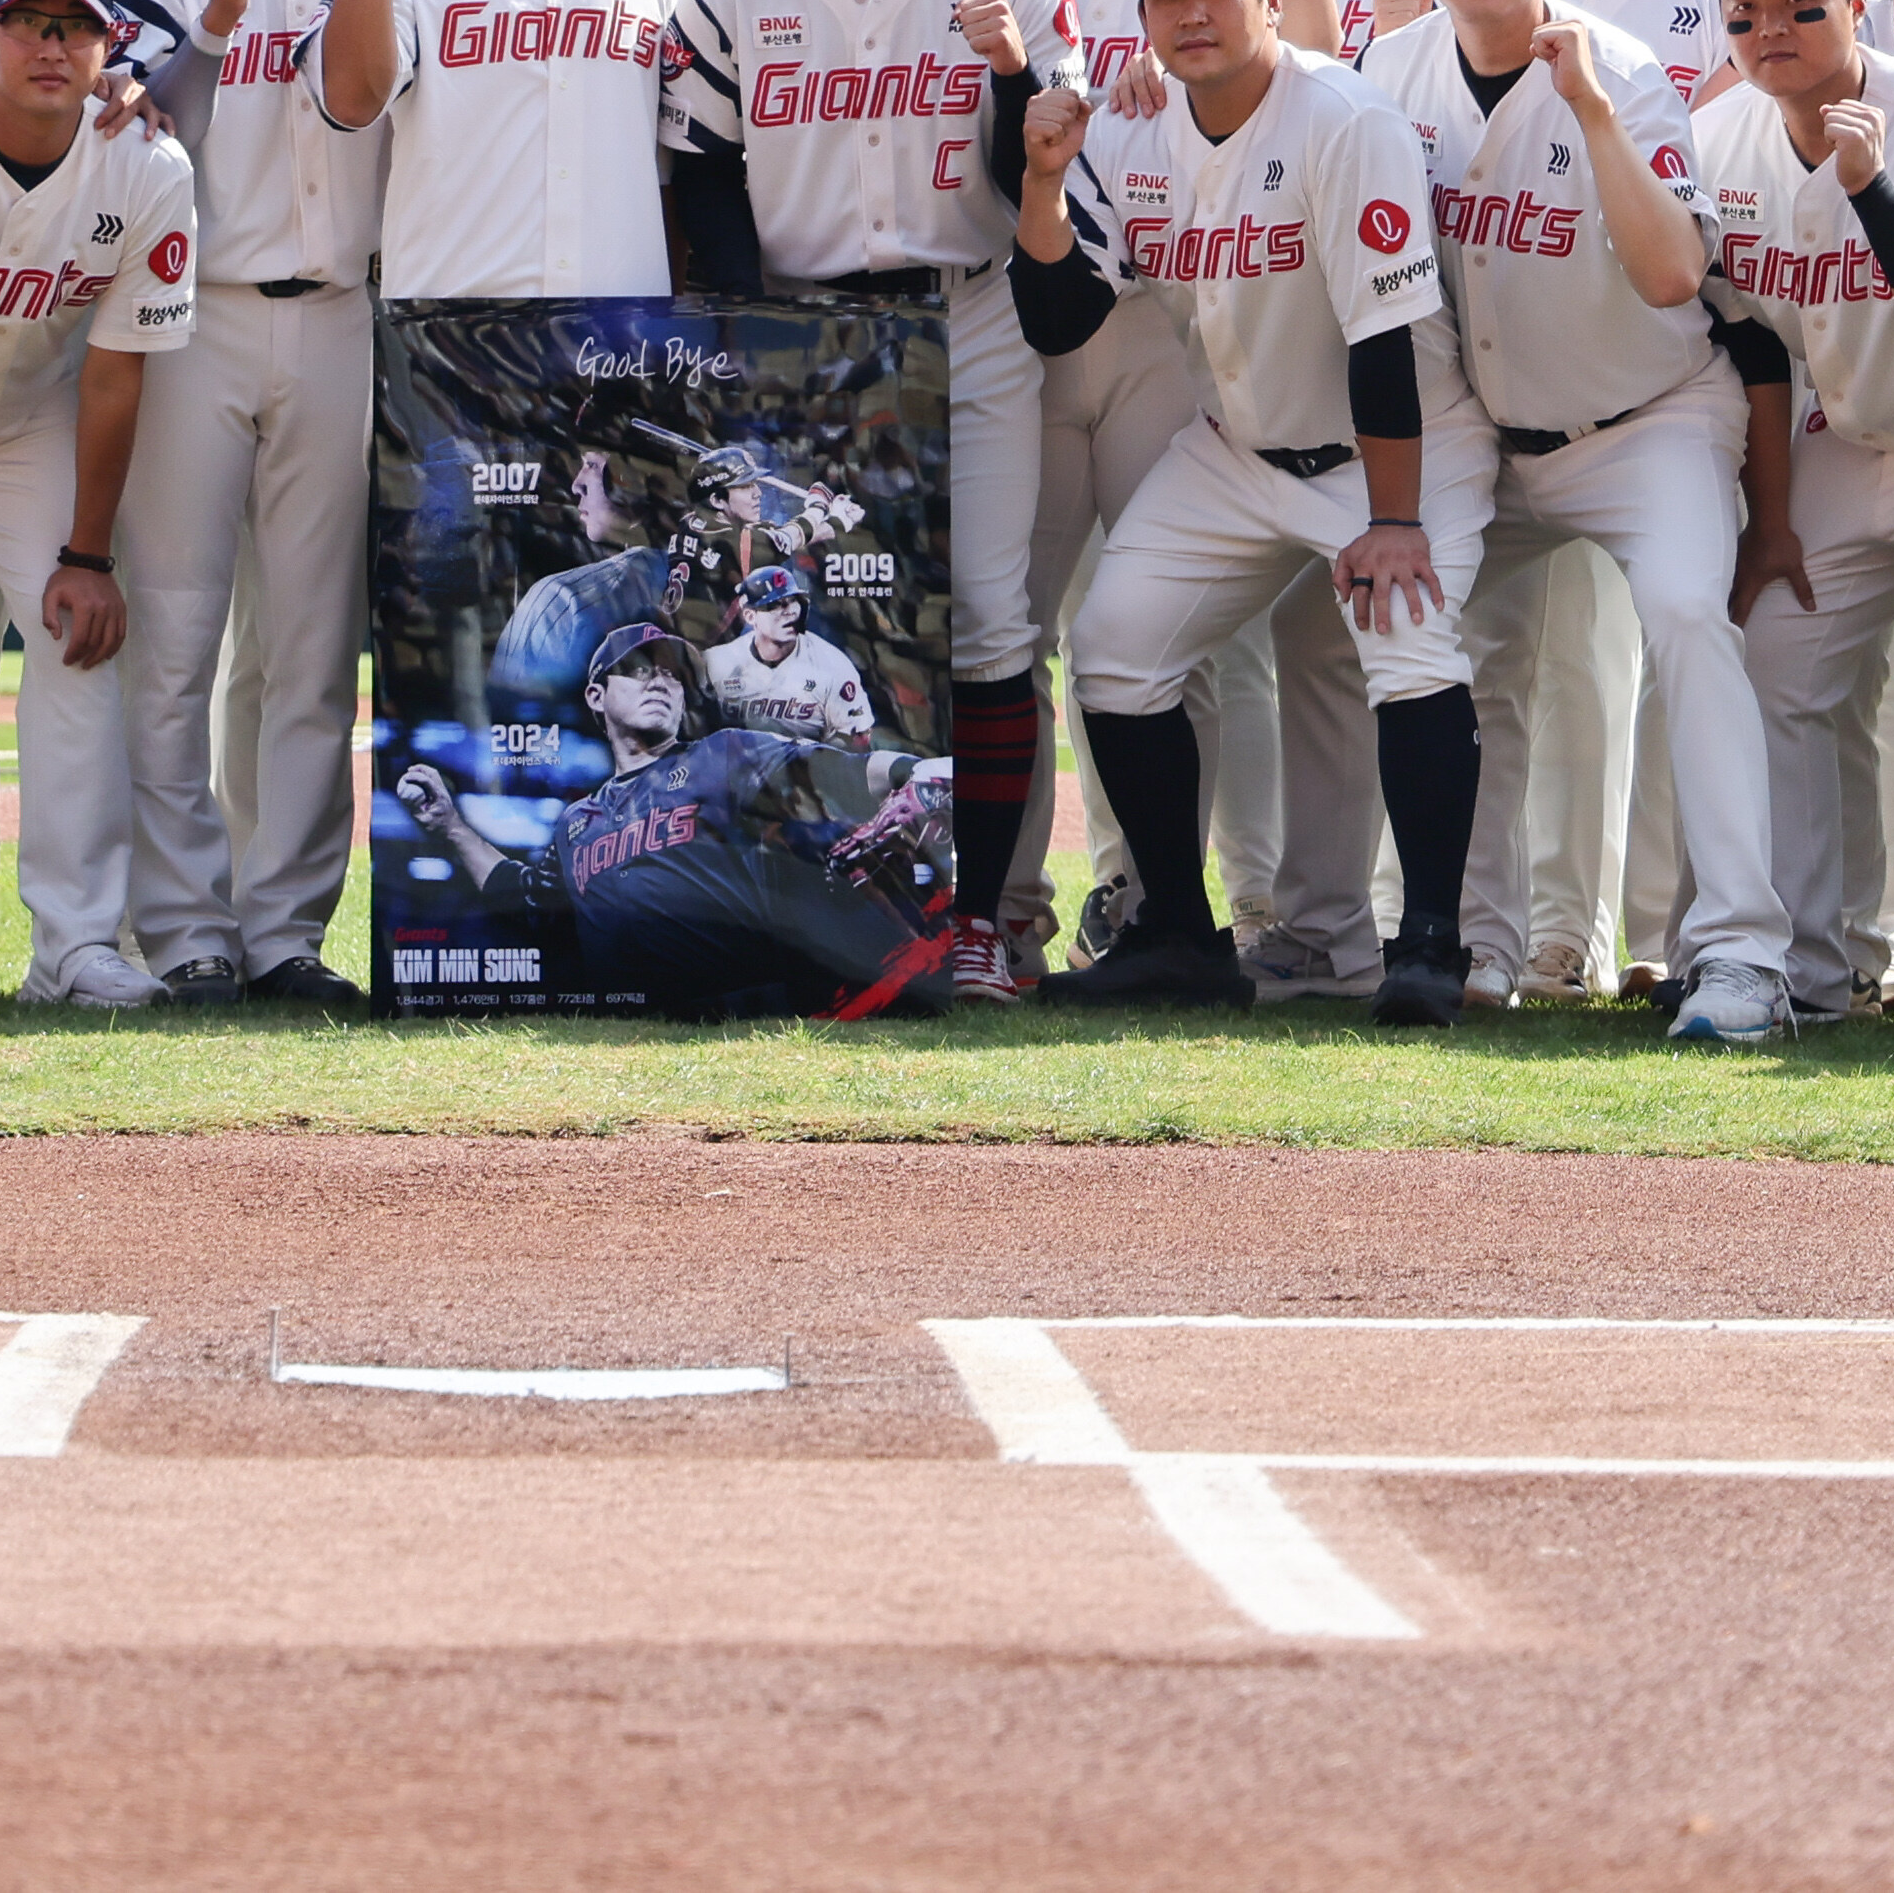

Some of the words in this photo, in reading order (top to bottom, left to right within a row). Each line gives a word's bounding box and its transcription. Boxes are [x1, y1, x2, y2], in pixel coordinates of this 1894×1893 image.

[759, 16, 804, 32] BNK
[749, 51, 989, 129] Giants
[931, 138, 974, 191] C
[1125, 172, 1169, 190] BNK
[1718, 188, 1759, 206] BNK
[1431, 183, 1584, 258] iants
[1370, 254, 1437, 296] 칠성사이다
[575, 336, 656, 387] Good
[664, 336, 739, 389] Bye
[472, 462, 542, 492] 2007
[825, 552, 895, 583] 2009
[490, 723, 561, 753] 2024
[393, 949, 433, 983] KIM
[438, 949, 479, 983] MIN
[484, 948, 541, 983] SUNG
